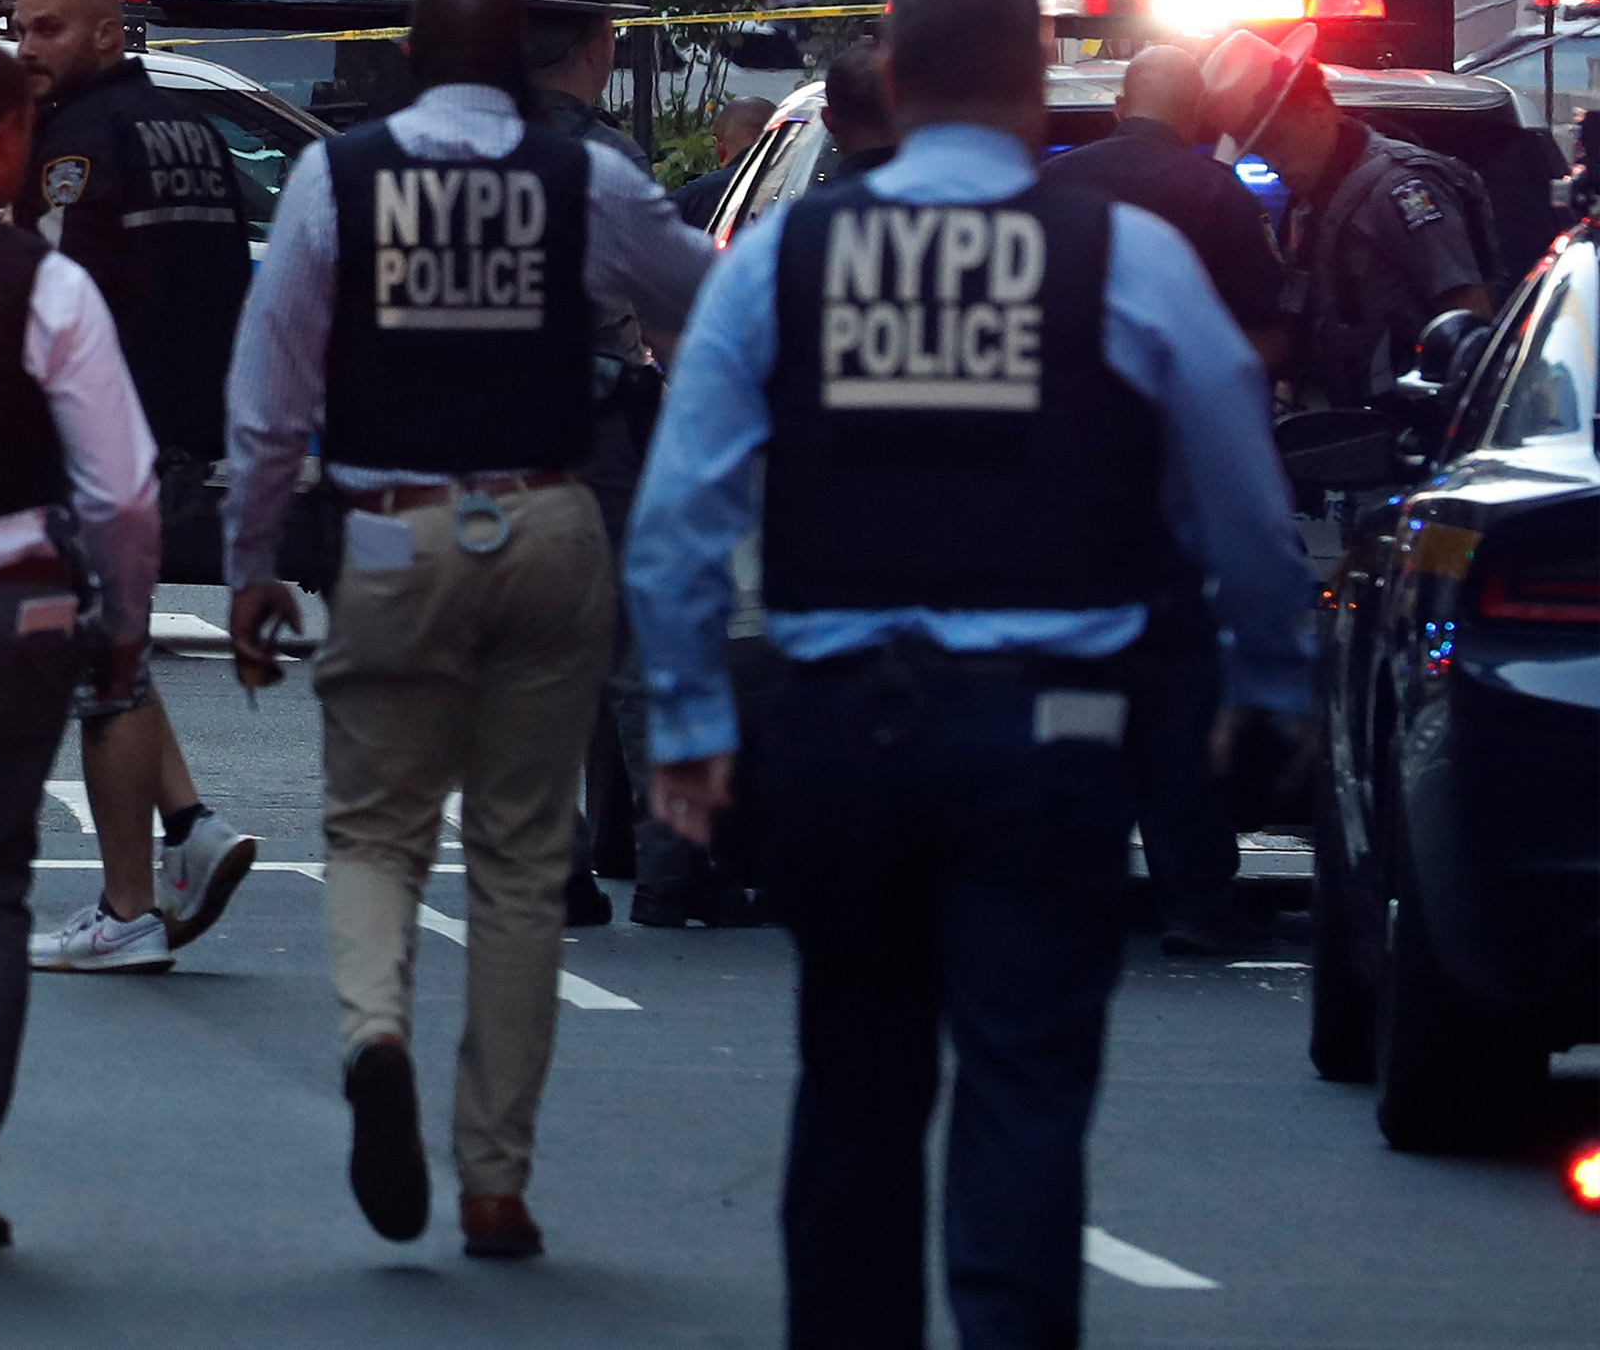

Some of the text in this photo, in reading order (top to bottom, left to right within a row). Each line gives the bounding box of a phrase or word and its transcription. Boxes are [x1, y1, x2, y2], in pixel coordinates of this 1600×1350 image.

[135, 120, 222, 168] NYP
[150, 168, 227, 199] POLIC
[373, 169, 548, 248] NYPD
[375, 250, 545, 307] POLICE
[826, 209, 1046, 302] NYPD
[824, 308, 1043, 379] POLICE
